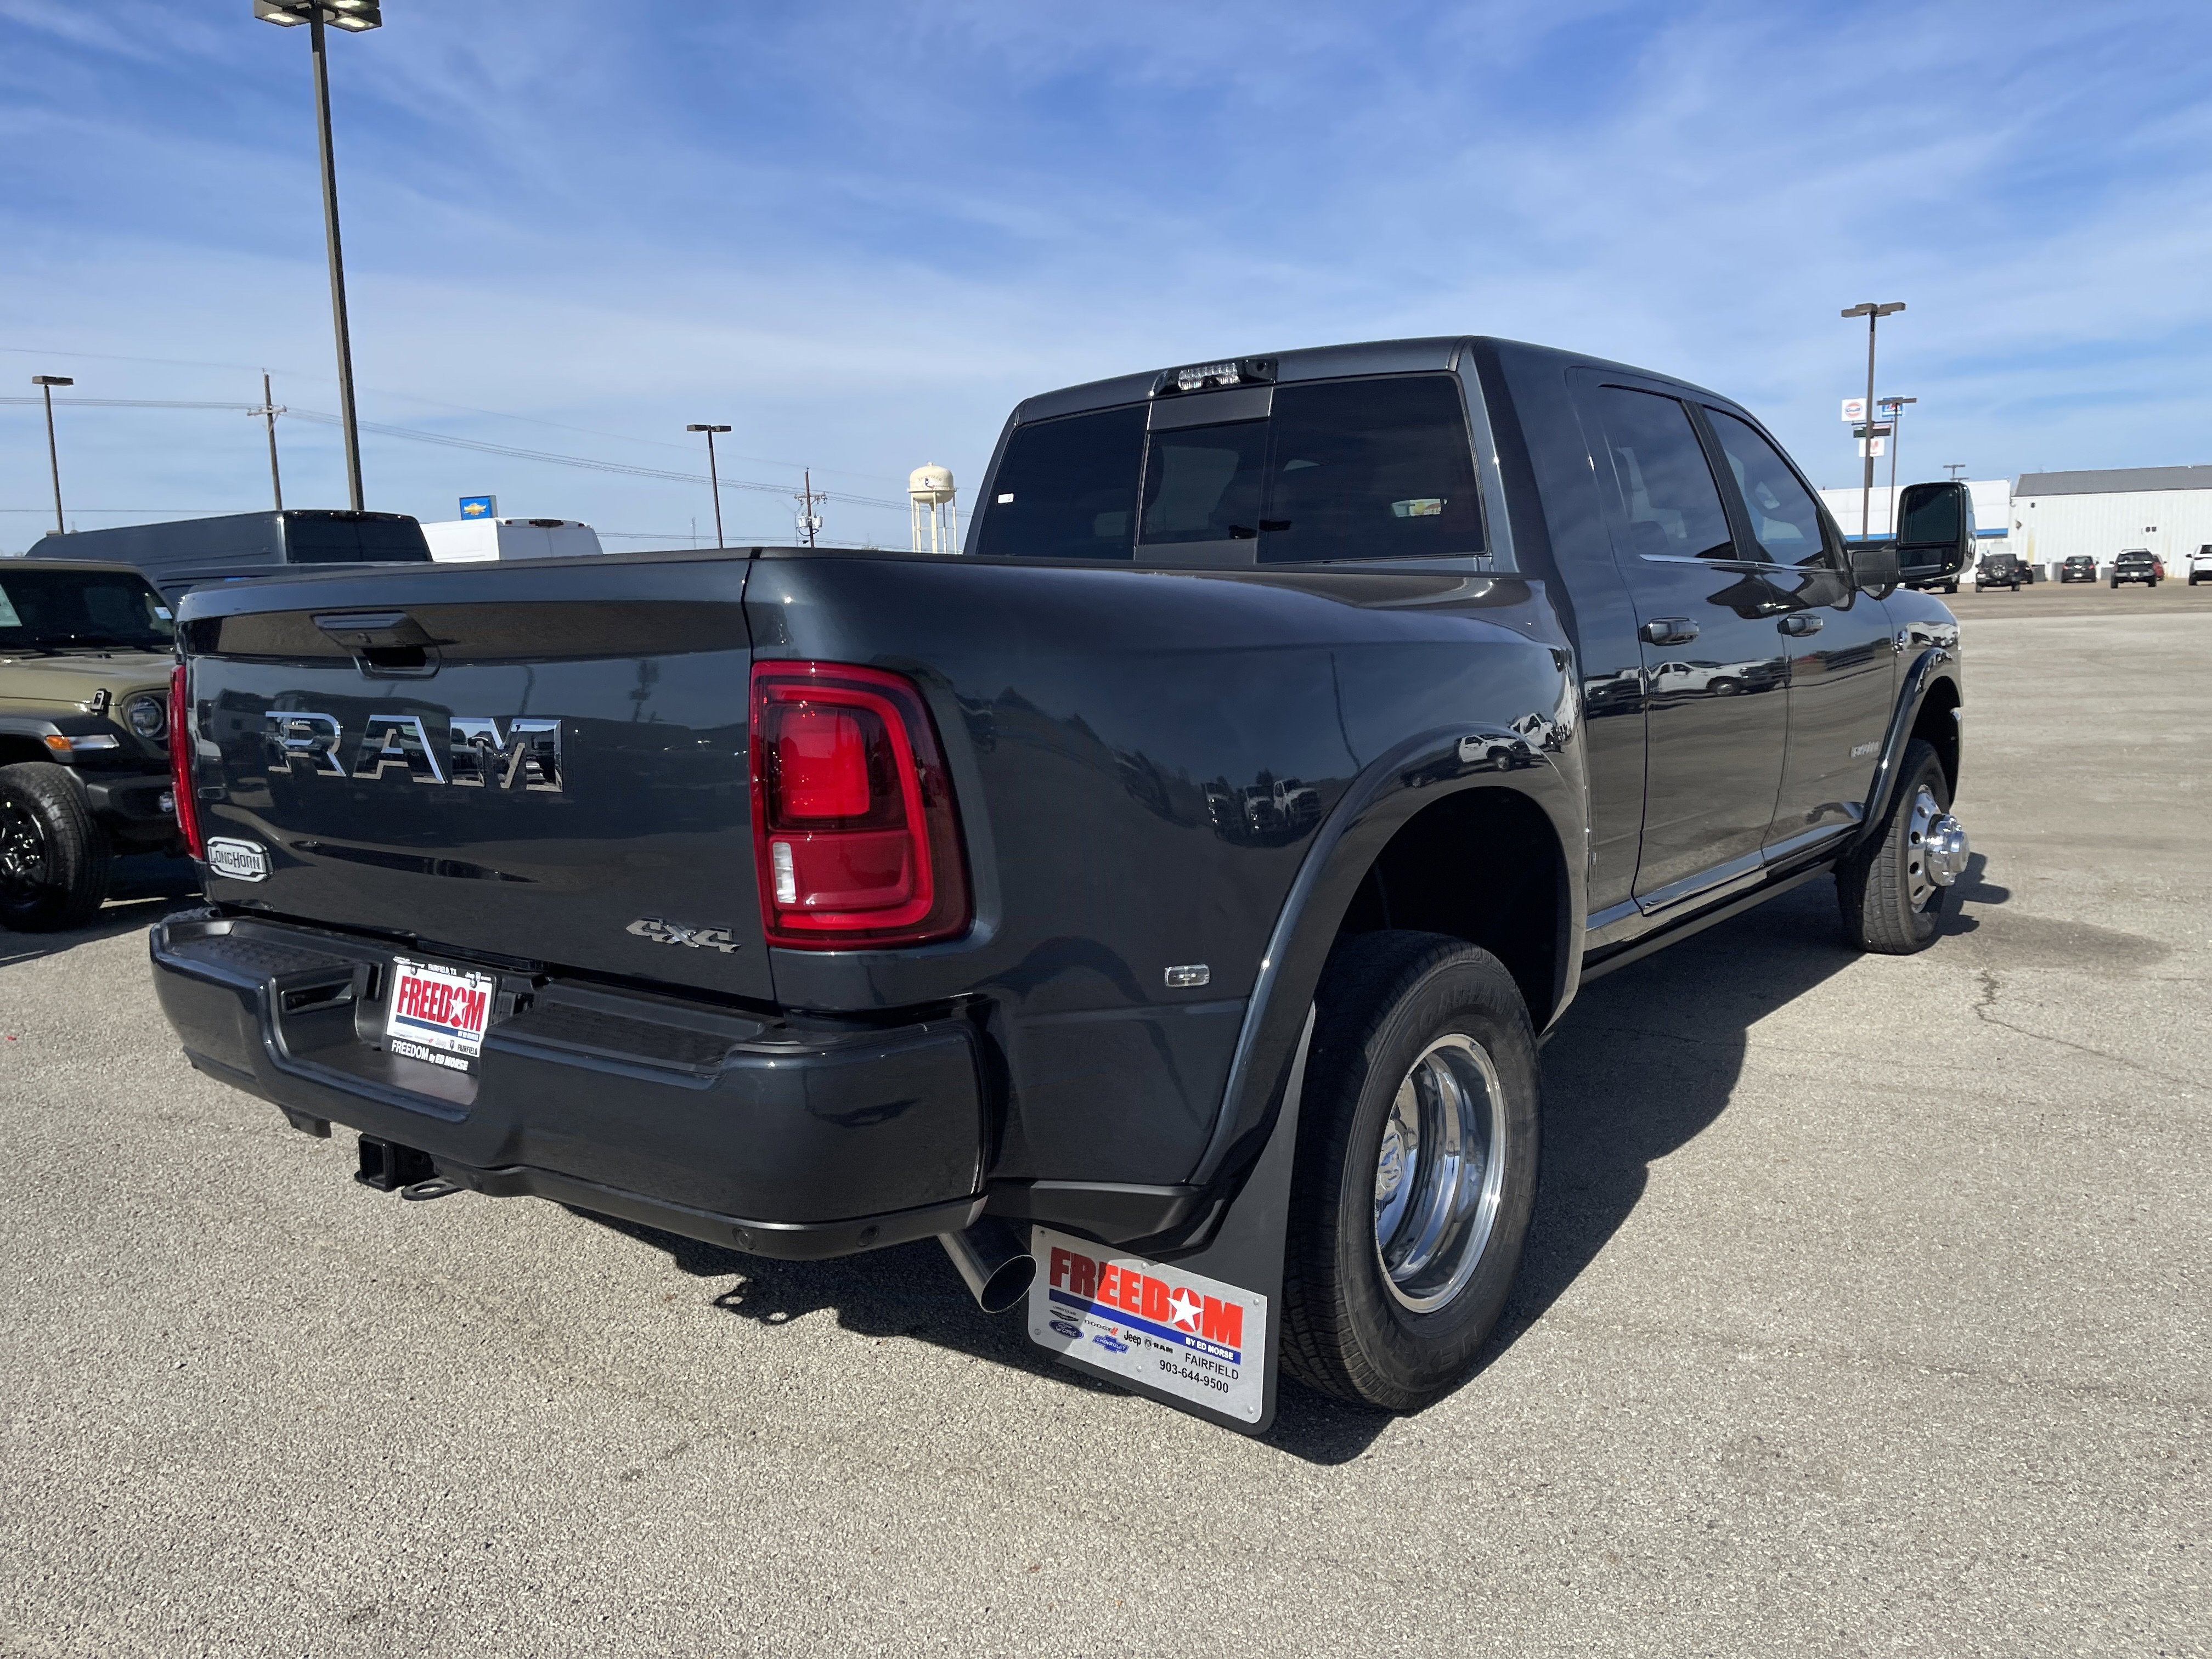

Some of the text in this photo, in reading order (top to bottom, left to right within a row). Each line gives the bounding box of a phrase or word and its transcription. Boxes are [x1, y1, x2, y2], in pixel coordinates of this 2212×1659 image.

[266, 711, 563, 793] RAM
[396, 975, 487, 1031] FREEDOM
[391, 1040, 430, 1061] FREEDOM
[435, 1053, 445, 1065] ED
[444, 1056, 469, 1071] MORSE
[458, 1044, 477, 1055] FAIRFIELD
[1049, 1246, 1243, 1349] FREEDOM
[1084, 1319, 1112, 1332] DODGE
[1124, 1330, 1142, 1347] Jeep
[1096, 1337, 1126, 1352] CHEVROLET
[1153, 1342, 1173, 1353] RAM
[1186, 1337, 1234, 1361] BY ED MORSE
[1160, 1359, 1228, 1393] 903-644-9500
[1185, 1352, 1239, 1380] FAIRFIELD
